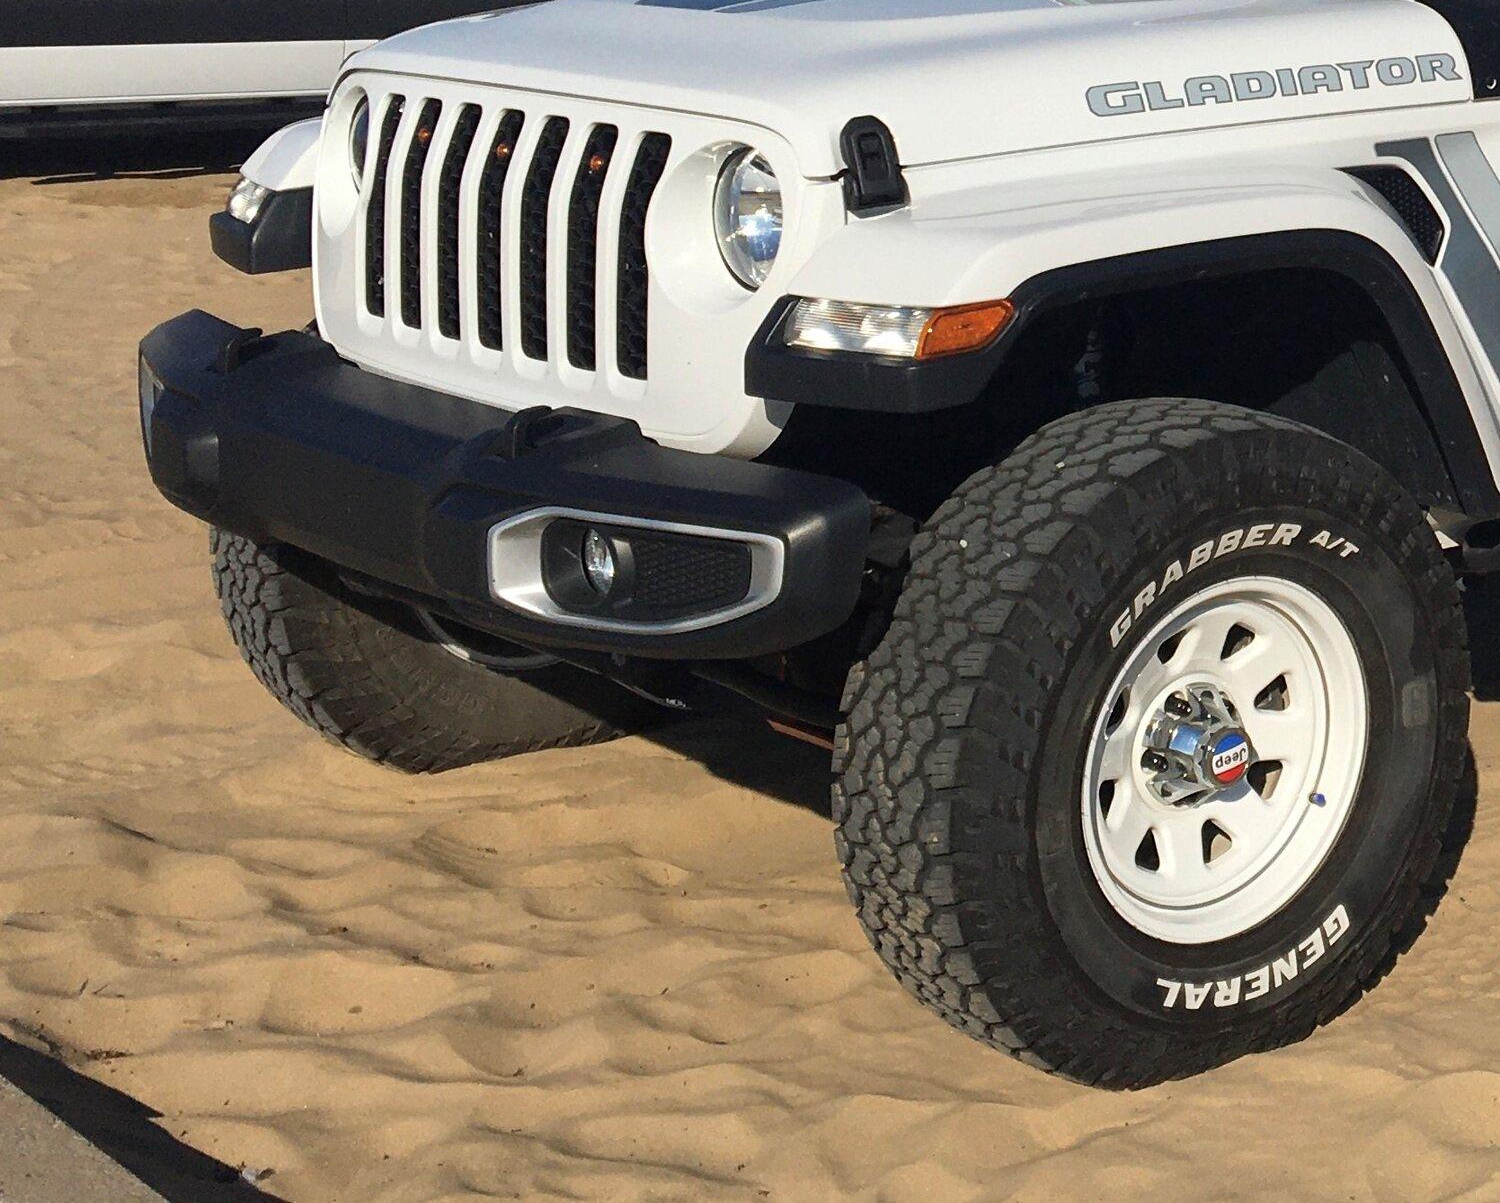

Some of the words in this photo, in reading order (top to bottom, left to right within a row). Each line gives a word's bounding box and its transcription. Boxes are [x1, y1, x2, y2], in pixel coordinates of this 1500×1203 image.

[1085, 52, 1463, 117] GLADIATOR
[1108, 522, 1302, 648] GRABBER
[1309, 529, 1360, 558] A/T
[1215, 747, 1246, 768] Jeep
[1156, 903, 1351, 1010] GENERAL
